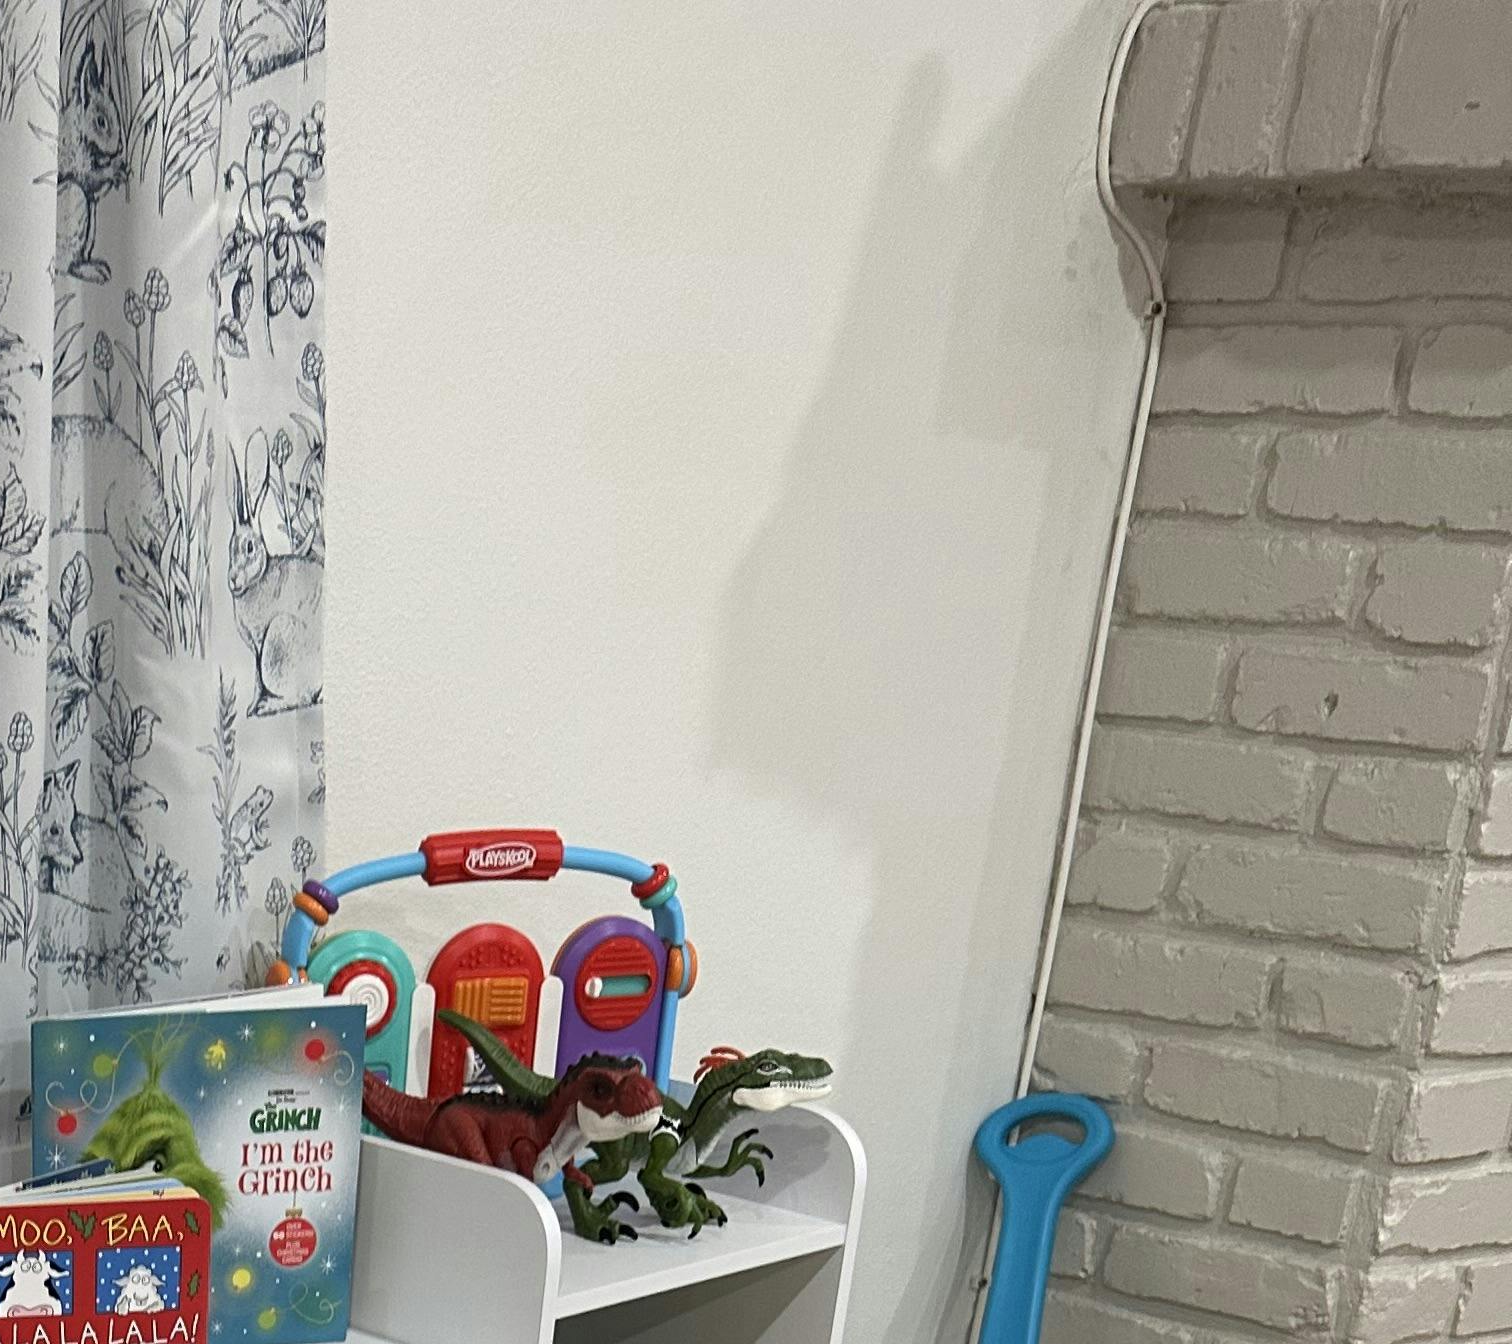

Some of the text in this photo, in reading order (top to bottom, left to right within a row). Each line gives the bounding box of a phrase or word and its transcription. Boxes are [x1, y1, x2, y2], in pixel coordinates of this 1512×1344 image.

[470, 849, 533, 868] PLAYSKOOL
[249, 1107, 322, 1134] GRINCH
[241, 1139, 334, 1167] I'm the
[238, 1166, 333, 1196] Grinch
[101, 1212, 185, 1247] BAA,
[152, 1314, 199, 1344] LA!
